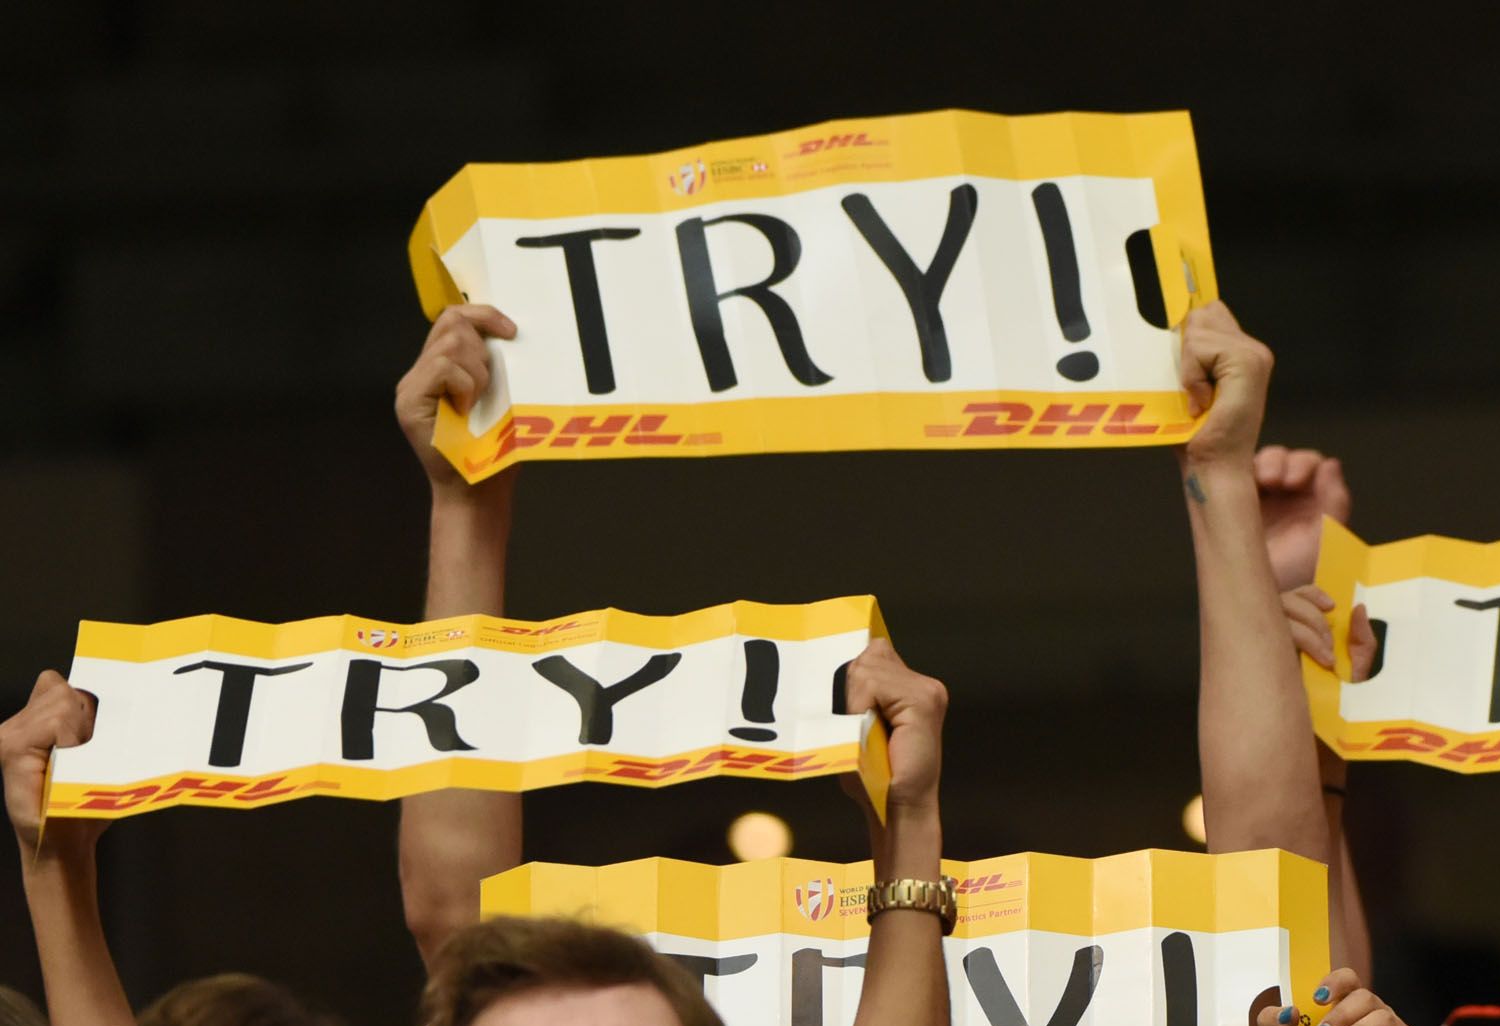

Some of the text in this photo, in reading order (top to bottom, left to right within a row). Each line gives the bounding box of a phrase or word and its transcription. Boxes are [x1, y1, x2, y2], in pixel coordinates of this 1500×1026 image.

[799, 133, 872, 154] DHL
[515, 181, 1100, 395] TRY!
[962, 402, 1160, 436] DHL
[494, 414, 684, 464] DHL
[173, 639, 781, 768] TRY!
[607, 750, 828, 781] DHL
[76, 776, 299, 811] DHL
[839, 907, 868, 917] SEVEN
[840, 894, 868, 908] HSB
[989, 906, 1024, 919] Partner
